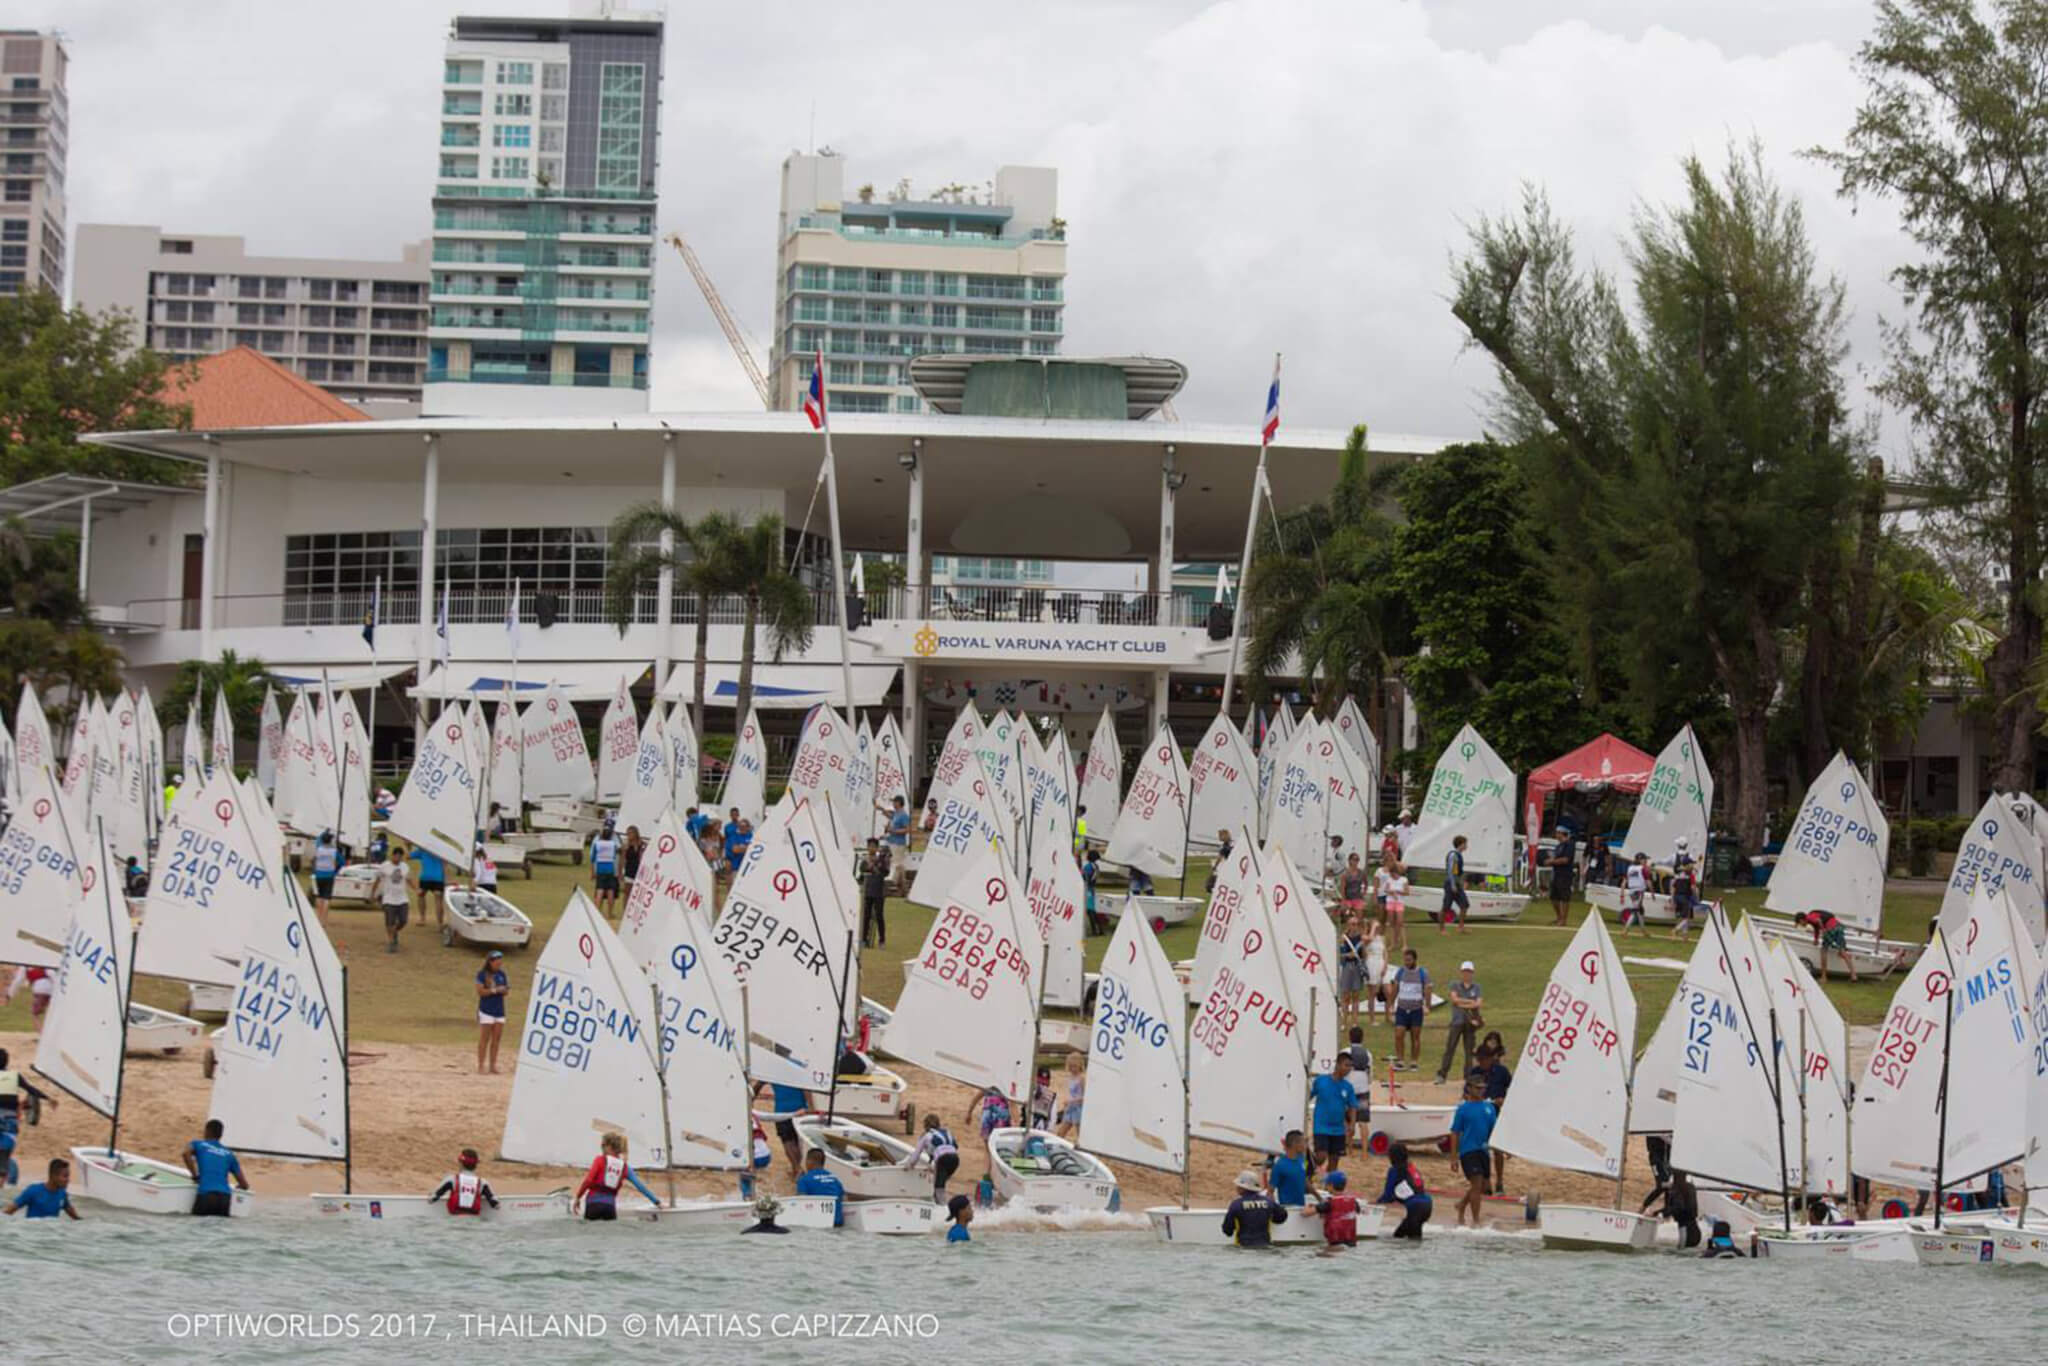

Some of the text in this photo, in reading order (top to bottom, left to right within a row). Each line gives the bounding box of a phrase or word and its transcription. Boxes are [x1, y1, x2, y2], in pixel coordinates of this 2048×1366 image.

[938, 636, 1167, 653] ROYAL VARUNA YACHT CLUB
[550, 717, 577, 735] HUN
[554, 744, 585, 763] 1373
[1213, 760, 1240, 783] FIN
[1430, 782, 1475, 806] 3325
[1472, 778, 1505, 799] JPN
[1650, 778, 1678, 800] 3110
[939, 814, 974, 840] 1715
[1802, 821, 1841, 847] 2691
[1845, 820, 1878, 849] POR
[36, 845, 76, 880] GBR
[169, 851, 221, 885] 2410
[225, 850, 266, 890] PUR
[2001, 857, 2033, 884] POR
[75, 930, 117, 985] UAE
[714, 924, 765, 960] 323
[777, 927, 829, 977] PER
[932, 927, 997, 977] 6464
[995, 938, 1030, 985] GBR
[1966, 959, 2012, 1006] MAS
[237, 986, 293, 1025] 1417
[532, 1000, 598, 1043] 1680
[1206, 991, 1240, 1033] 5213
[1243, 991, 1298, 1037] PUR
[685, 1008, 736, 1052] CAN
[1127, 1001, 1169, 1048] HKG
[1537, 1009, 1578, 1051] 328
[1688, 1017, 1713, 1047] 12
[1879, 1027, 1918, 1064] 129
